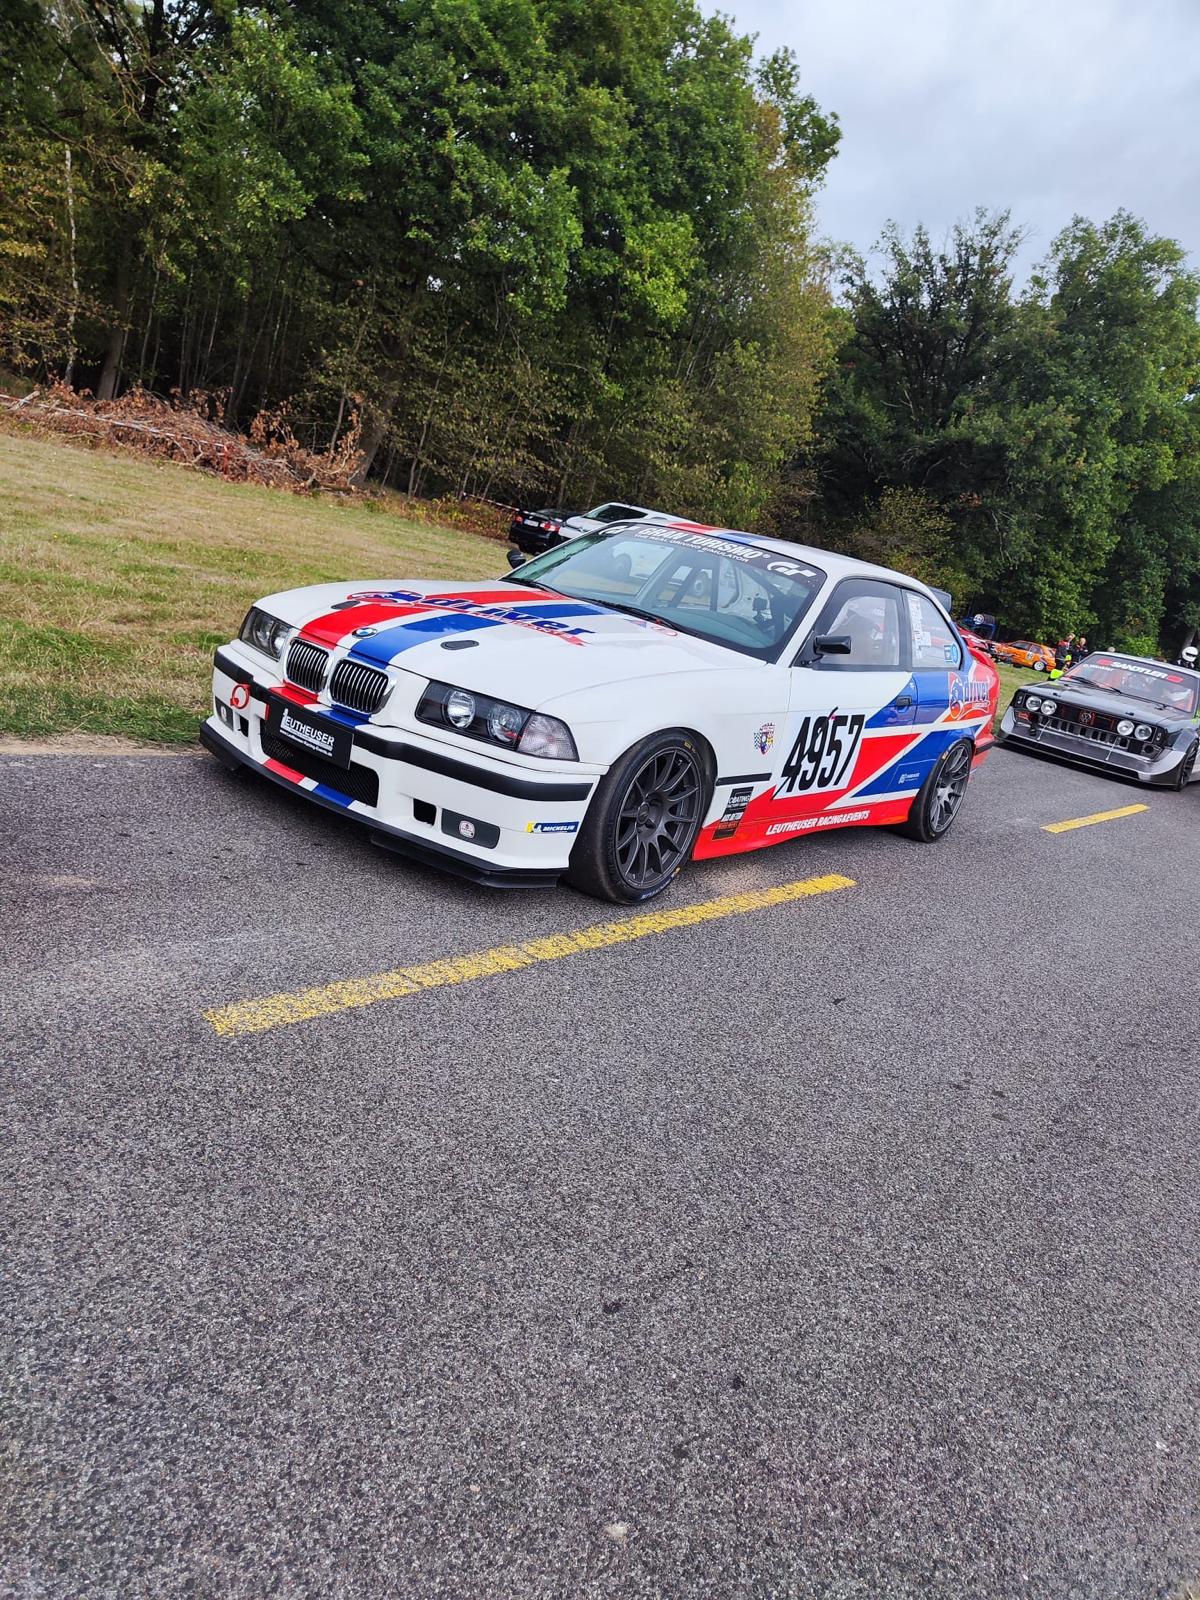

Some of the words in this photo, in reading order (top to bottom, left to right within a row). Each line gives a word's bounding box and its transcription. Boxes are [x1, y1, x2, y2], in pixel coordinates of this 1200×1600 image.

[638, 527, 688, 542] GRAN
[685, 534, 764, 559] TURISMO
[671, 538, 701, 550] DRIVING
[700, 546, 750, 563] SIMULATOR
[1111, 660, 1168, 680] SANDTLER
[781, 715, 866, 793] 4957
[542, 825, 576, 833] MICHELIN
[766, 819, 817, 835] LEUTHEUSER
[817, 810, 870, 826] RACING&EVENTS
